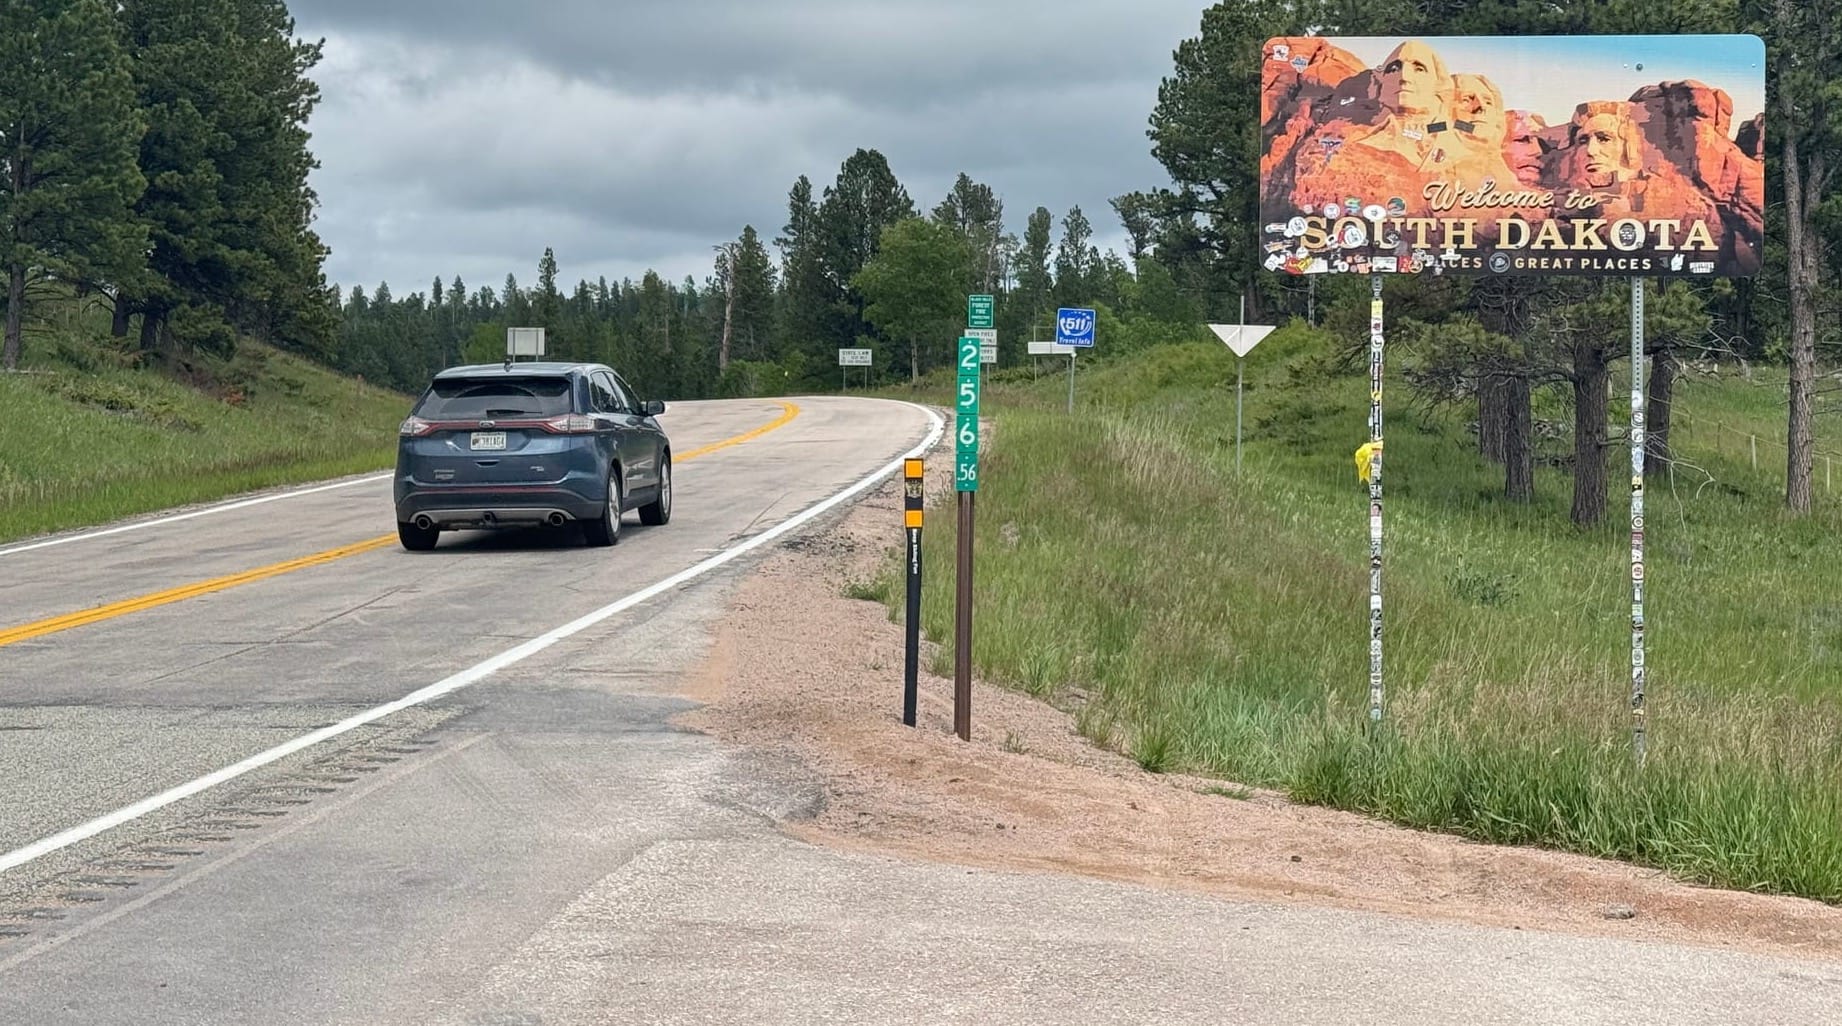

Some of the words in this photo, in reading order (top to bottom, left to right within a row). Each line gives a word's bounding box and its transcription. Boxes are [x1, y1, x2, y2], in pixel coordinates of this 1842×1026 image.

[1423, 179, 1555, 212] Welcome
[1566, 190, 1598, 210] to
[1299, 216, 1478, 250] SOUTH
[1495, 218, 1719, 251] DAKOTA
[1514, 257, 1573, 269] GREAT
[1580, 257, 1652, 269] PLACES
[1066, 317, 1087, 331] 511
[1059, 336, 1078, 344] Travel
[1078, 337, 1091, 345] Info
[957, 463, 977, 482] .56
